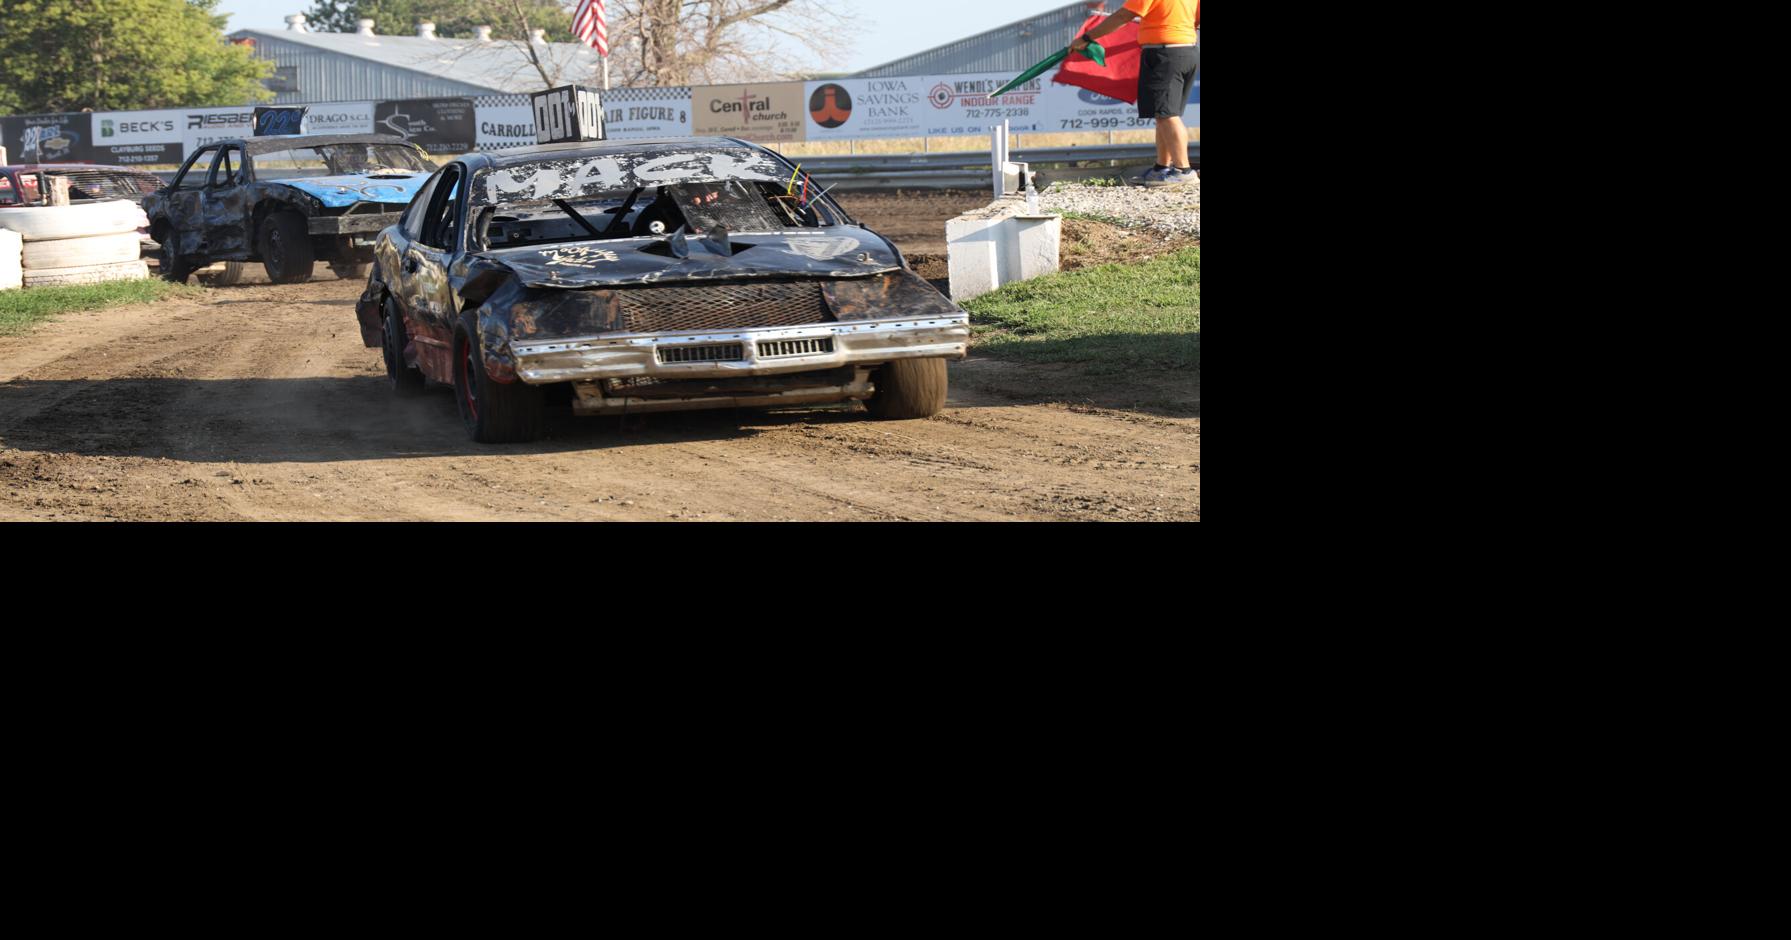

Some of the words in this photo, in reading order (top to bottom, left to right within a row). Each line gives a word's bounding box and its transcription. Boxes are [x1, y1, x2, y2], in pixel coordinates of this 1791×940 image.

[867, 80, 908, 92] IOWA
[954, 79, 994, 93] WENDL'S
[857, 92, 919, 106] SAVINGS
[960, 96, 999, 107] INDOOR
[1002, 95, 1035, 105] RANGE
[710, 88, 770, 124] Central
[868, 105, 910, 118] BANK
[309, 113, 348, 123] DRAGO
[629, 106, 674, 121] FIGURE
[679, 110, 686, 123] 8
[752, 111, 787, 121] church
[119, 121, 174, 132] BECK'S
[481, 120, 536, 138] CARROLL
[1060, 116, 1157, 129] 712-999-367
[486, 152, 781, 203] MACK
